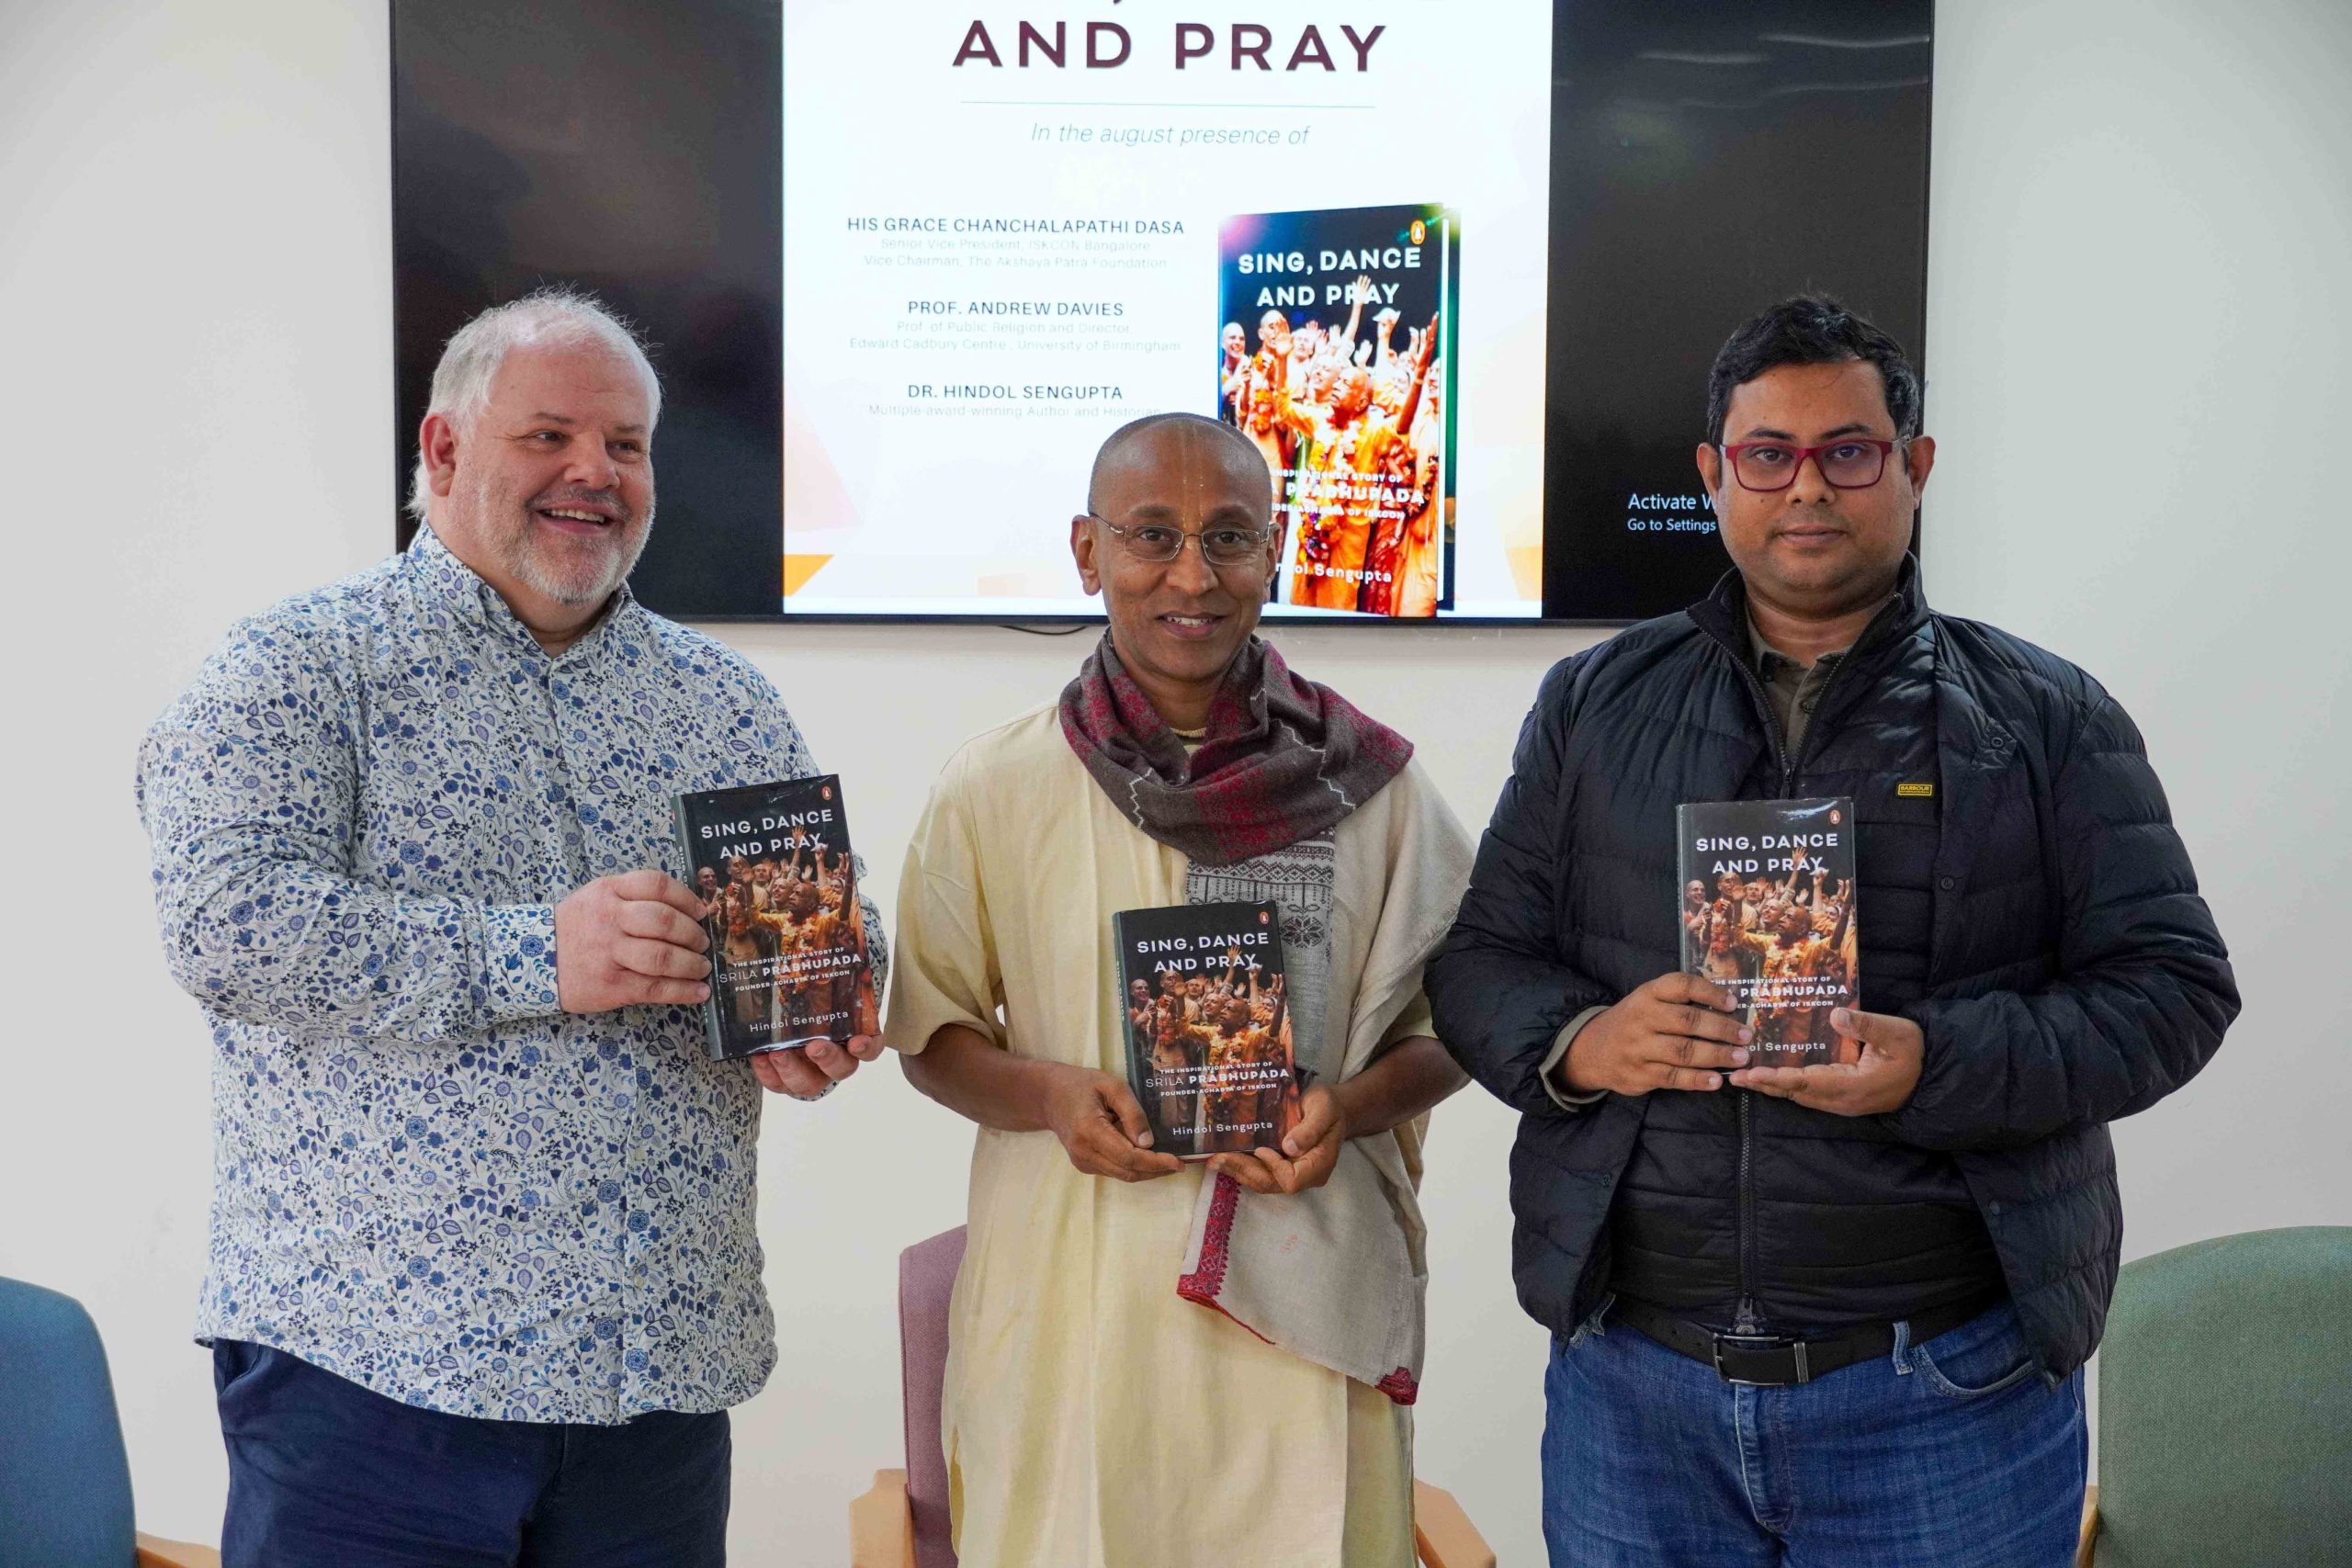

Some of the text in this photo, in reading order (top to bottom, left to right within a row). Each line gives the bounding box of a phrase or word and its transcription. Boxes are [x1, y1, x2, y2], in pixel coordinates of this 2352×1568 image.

[952, 19, 1386, 73] AND PRAY
[1031, 123, 1311, 147] In the august presence of
[847, 218, 1184, 234] HIS GRACE CHANCHALAPATHI DASA
[881, 238, 922, 250] Senior
[927, 239, 956, 251] Vice
[1029, 240, 1080, 252] ISKCON
[1084, 240, 1151, 254] Bangalore
[864, 255, 892, 266] Vice
[968, 256, 992, 267] The
[996, 256, 1051, 270] Akshaya
[1056, 257, 1088, 268] Patra
[1238, 247, 1421, 276] SING, DANCE
[1256, 283, 1399, 307] AND PRAY
[908, 300, 1124, 316] PROF. ANDREW DAVIES
[930, 321, 944, 333] of
[947, 321, 988, 333] Public
[992, 322, 1046, 336] Religion
[1049, 322, 1074, 333] and
[850, 337, 899, 349] Edward
[902, 338, 958, 352] Cadbury
[1017, 340, 1081, 354] University
[1086, 340, 1098, 351] of
[1102, 340, 1181, 354] Birmingham
[908, 385, 1123, 400] DR. HINDOL SENGUPTA
[1026, 405, 1069, 417] Author
[1075, 406, 1099, 417] and
[1387, 474, 1403, 483] OF
[1628, 492, 1697, 510] Activate
[1348, 507, 1361, 516] OF
[1627, 518, 1716, 534] Go to Settings
[1314, 562, 1392, 584] Sengupta
[701, 808, 833, 839] SING, DANCE
[719, 832, 821, 859] AND PRAY
[1696, 832, 1838, 852] SING, DANCE
[1712, 856, 1823, 874] AND PRAY
[1136, 932, 1269, 953] SING, DANCE
[750, 953, 808, 965] INSPIRATIONAL
[809, 948, 833, 957] STORY
[1154, 953, 1257, 973] AND PRAY
[719, 953, 862, 984] SRILA PRABHUPADA
[821, 969, 850, 979] ISKCON
[1740, 985, 1848, 998] PRABHUPADA
[750, 1010, 849, 1032] Hindol Sengupta
[1766, 1042, 1826, 1054] Sengupta
[1177, 1064, 1235, 1074] INSPIRATIONAL
[1146, 1068, 1289, 1088] SRILA PRABHUPADA
[1172, 1122, 1273, 1136] Hindol Sengupta
